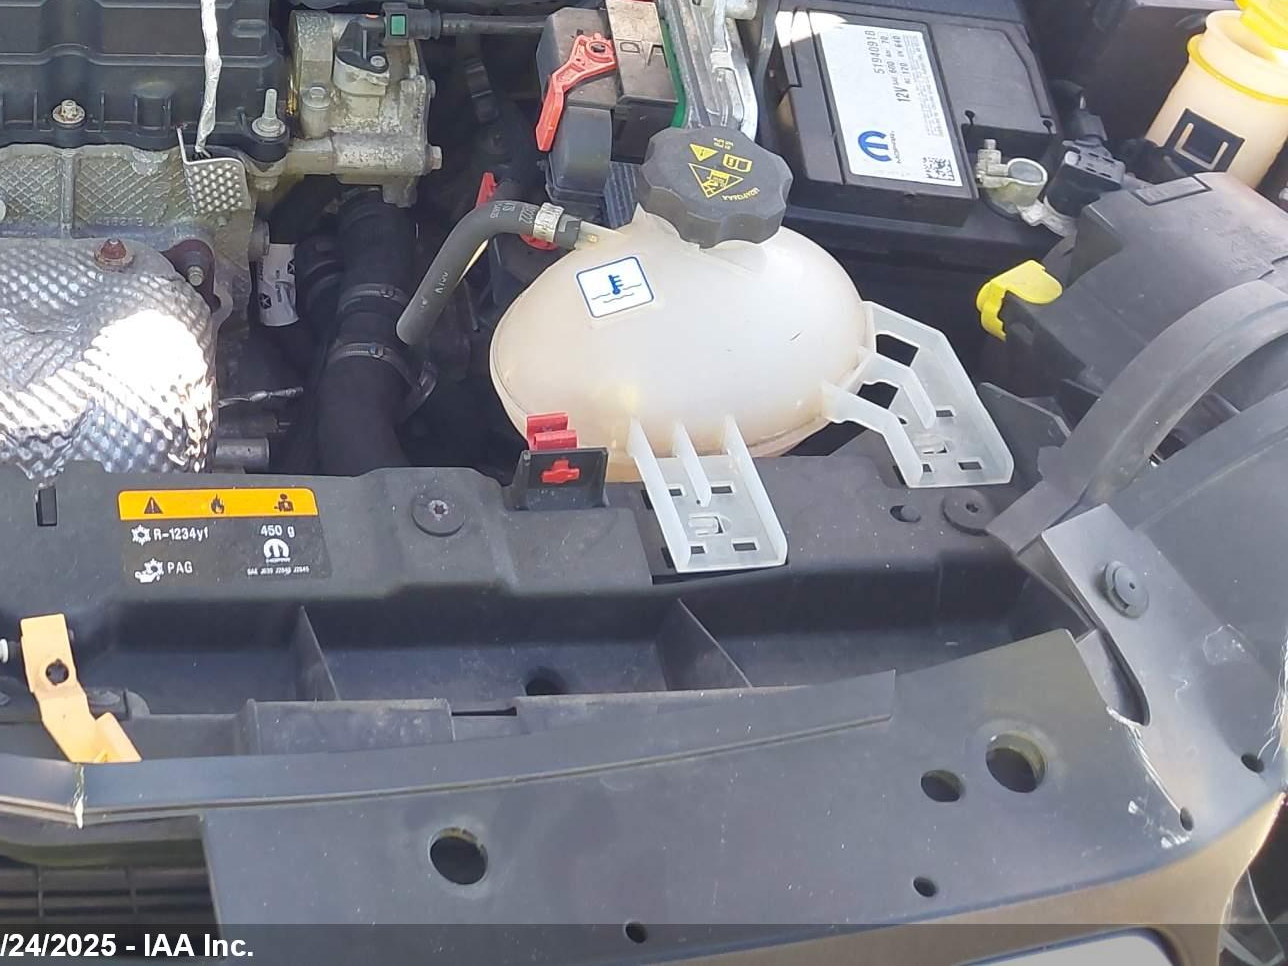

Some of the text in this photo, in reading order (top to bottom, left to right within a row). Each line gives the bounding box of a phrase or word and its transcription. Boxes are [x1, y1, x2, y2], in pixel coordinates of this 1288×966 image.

[894, 86, 911, 102] 12V
[153, 526, 209, 541] R-1234yf
[260, 524, 295, 538] 450 g
[167, 561, 193, 575] PAG
